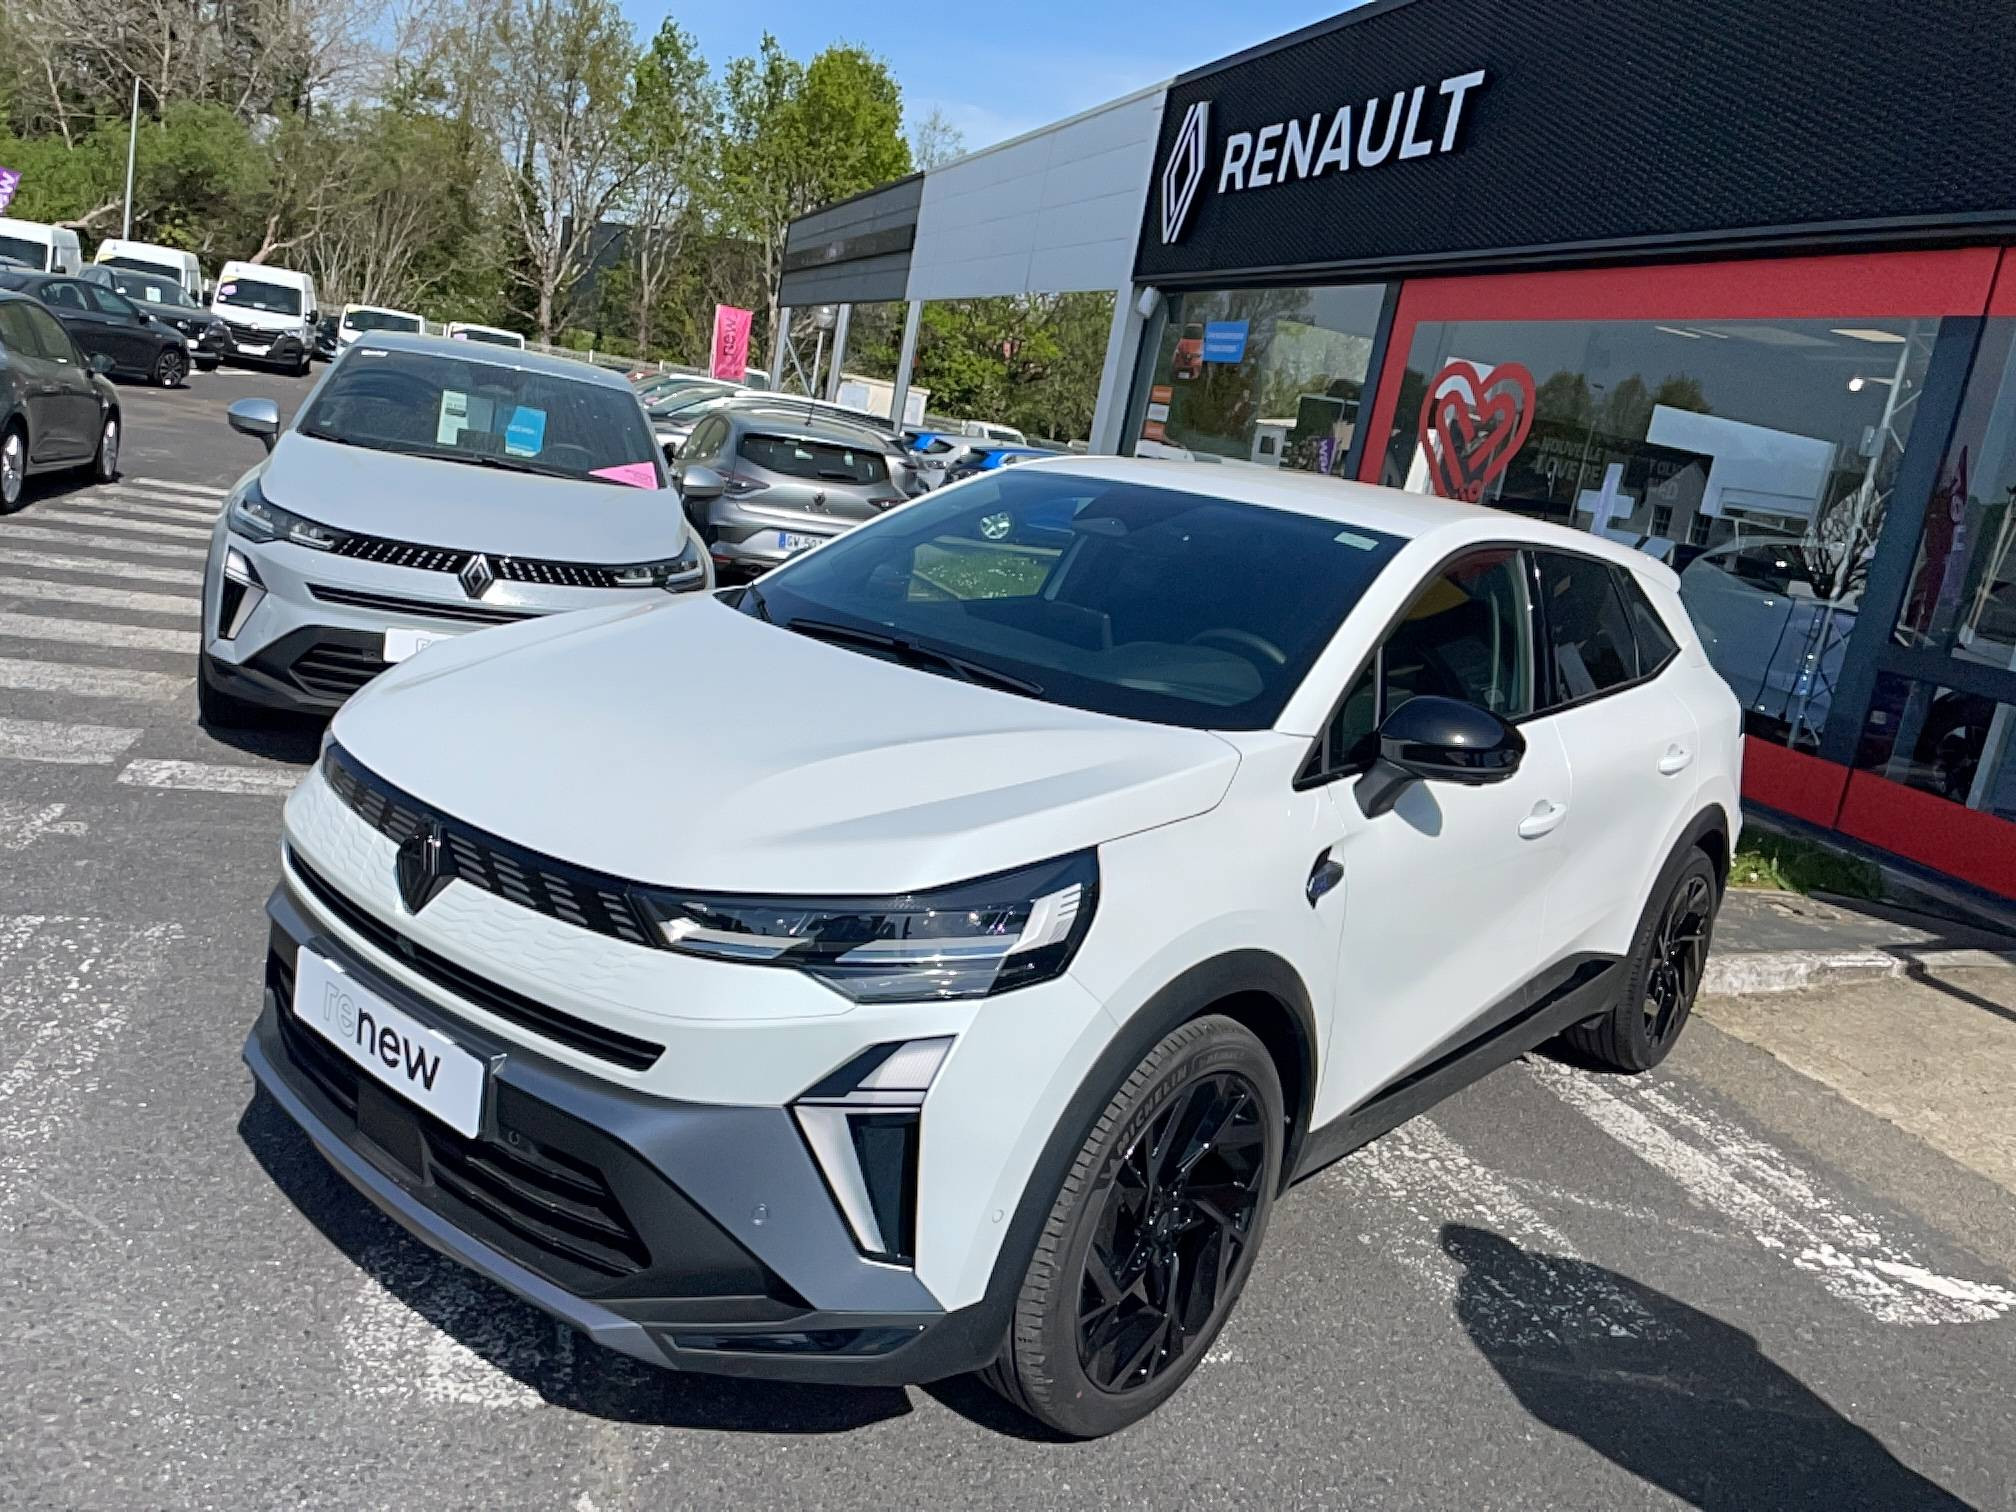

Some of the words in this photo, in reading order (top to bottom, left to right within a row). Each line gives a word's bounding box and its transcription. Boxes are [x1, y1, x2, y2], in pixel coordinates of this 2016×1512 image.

[1217, 69, 1486, 194] RENAULT
[324, 981, 441, 1091] renew
[1117, 1065, 1187, 1156] MICHELIN
